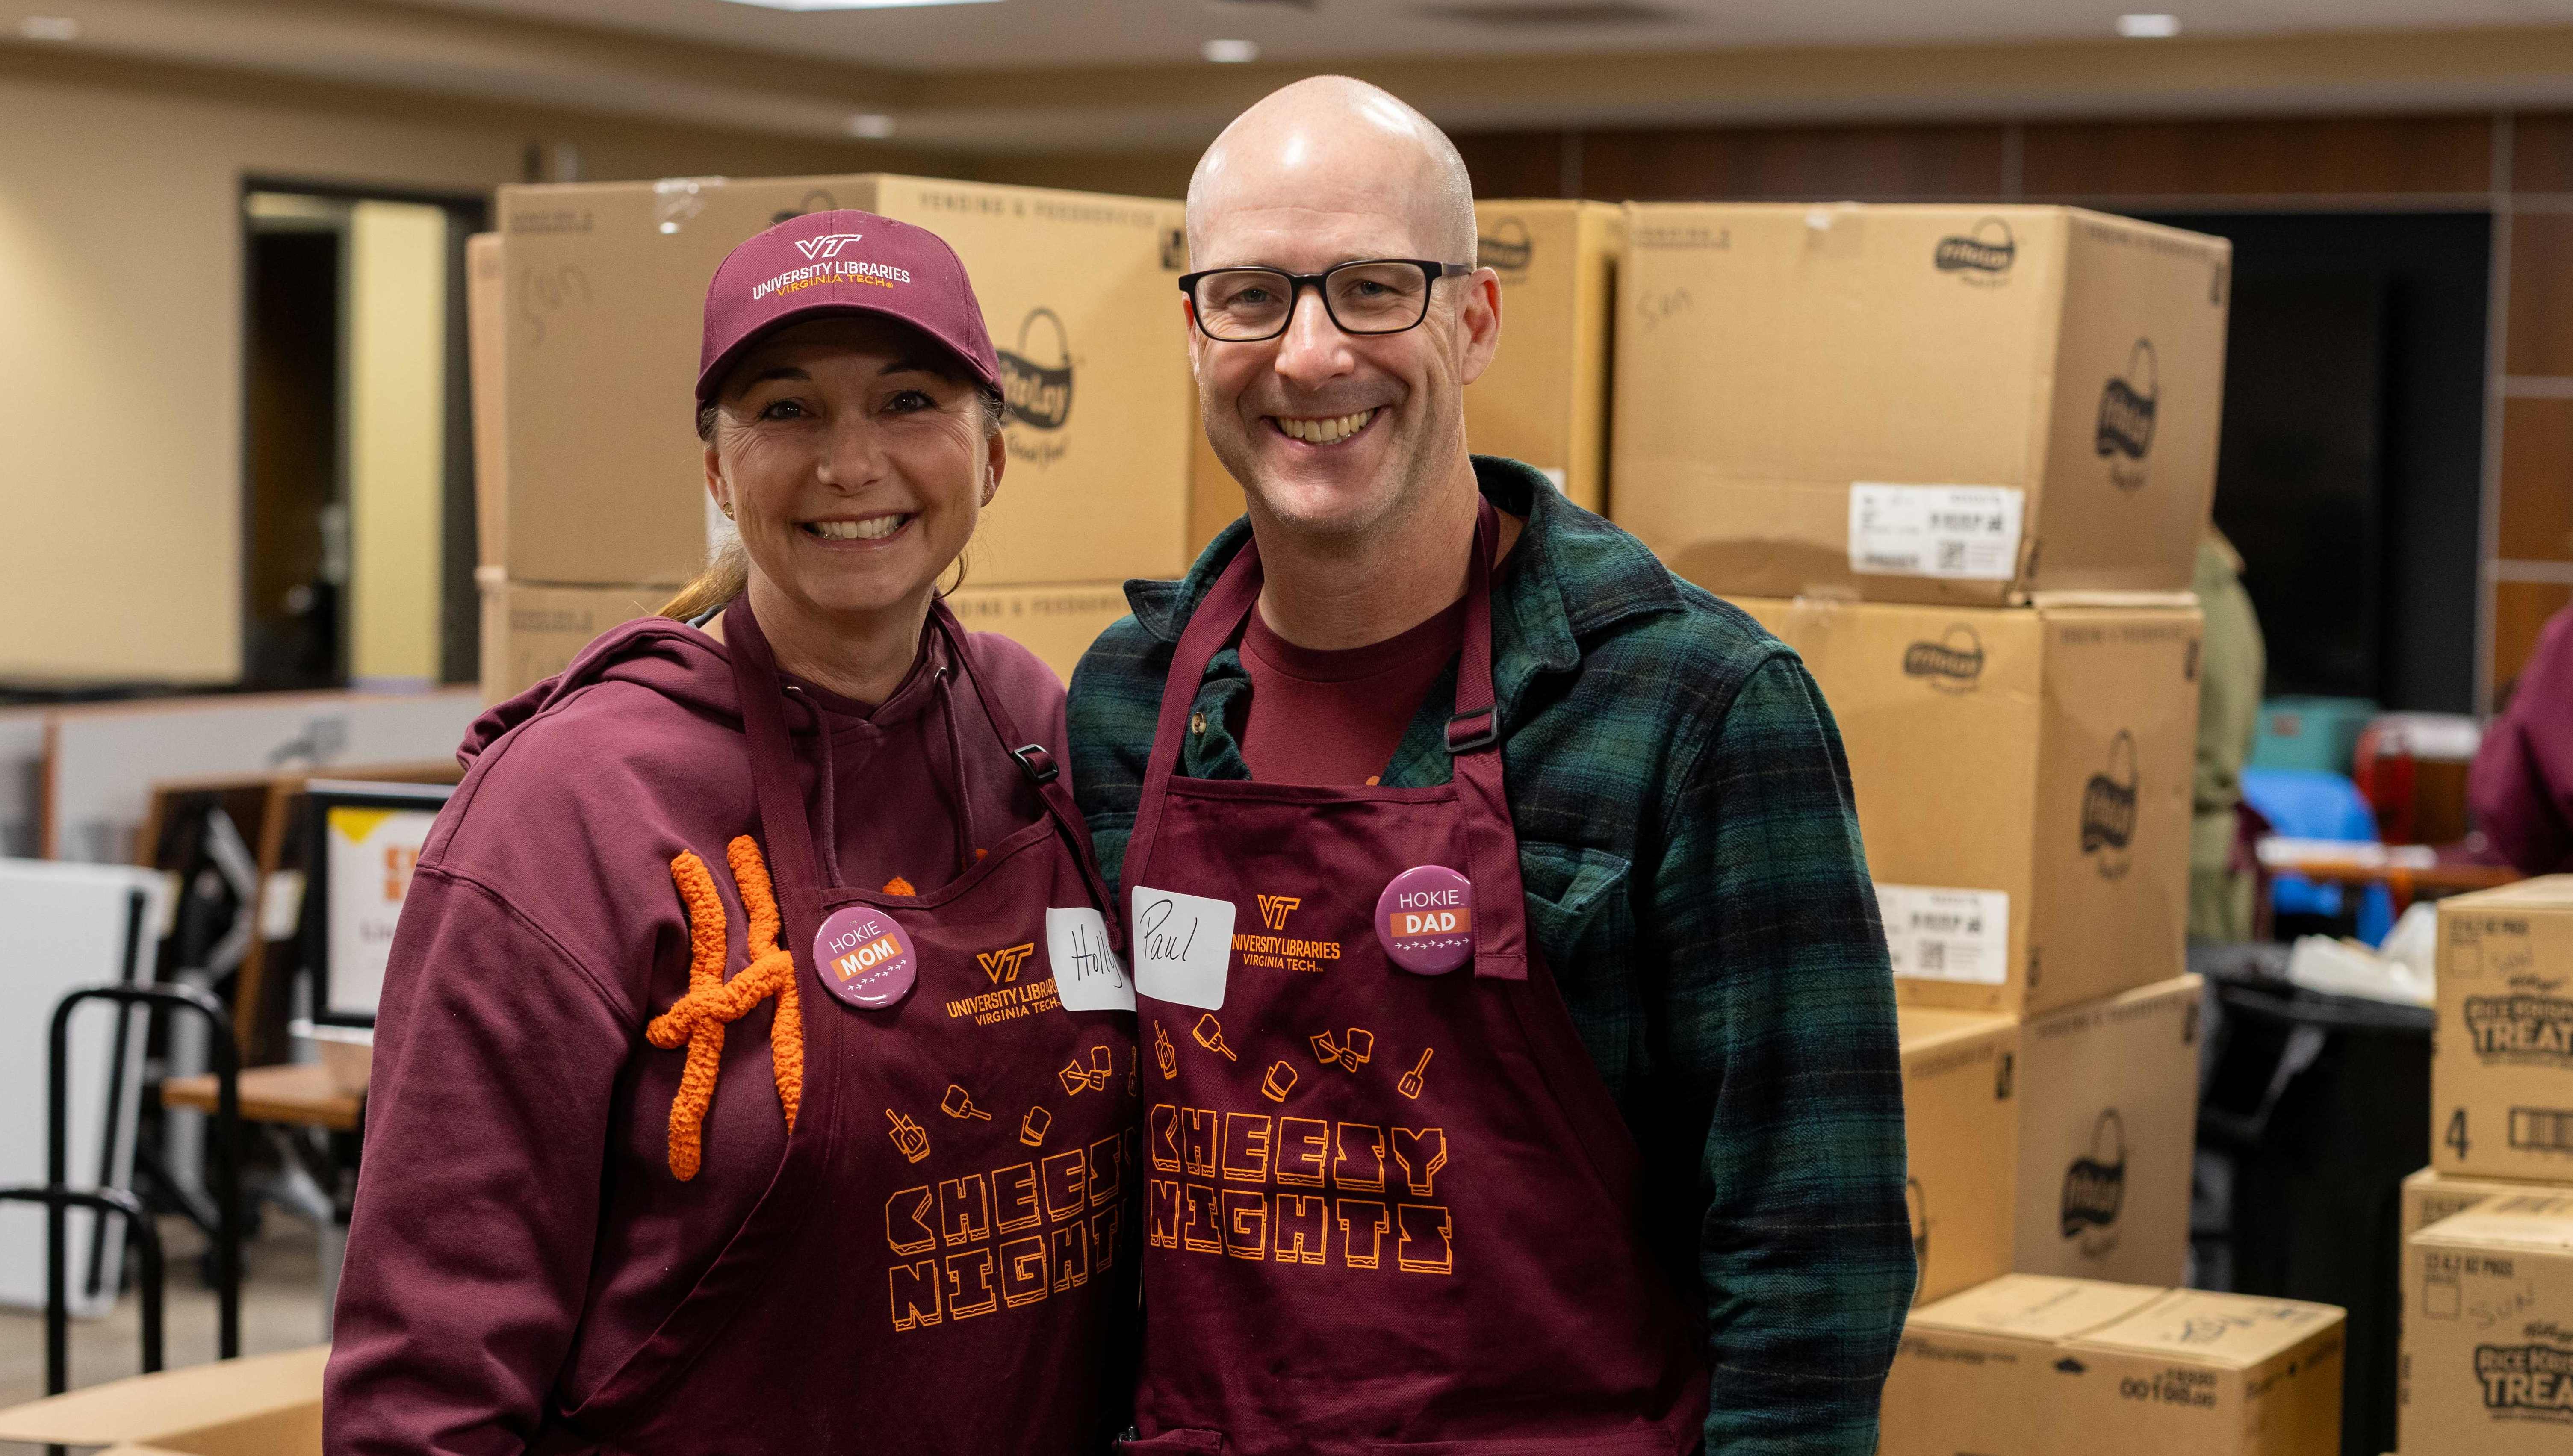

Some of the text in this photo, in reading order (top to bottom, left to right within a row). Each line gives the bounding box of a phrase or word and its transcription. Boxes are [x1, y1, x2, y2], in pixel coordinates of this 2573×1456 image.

[795, 234, 862, 260] VT
[752, 261, 911, 300] UNIVERSITY LIBRARIES
[776, 274, 843, 296] VIRGINIA
[1257, 894, 1301, 930] VT
[1399, 890, 1460, 908] HOKIE
[829, 920, 882, 954] HOKIE
[1140, 899, 1198, 962] Paul
[1406, 912, 1456, 934] DAD
[840, 938, 895, 976] MOM
[976, 942, 1034, 984] VT
[1071, 924, 1123, 988] Holly
[1232, 934, 1340, 960] NIVERSITY LIBRARIES
[1243, 954, 1284, 970] VIRGINIA
[946, 986, 1016, 1018] UNIVERSITY
[975, 1005, 1030, 1026] VIRGINIA
[1151, 1104, 1447, 1196] CHEESY
[2444, 1107, 2470, 1161] 4
[886, 1126, 1136, 1256] CHEES
[1151, 1179, 1452, 1274] NIGHTS
[889, 1198, 1130, 1332] NIGHT
